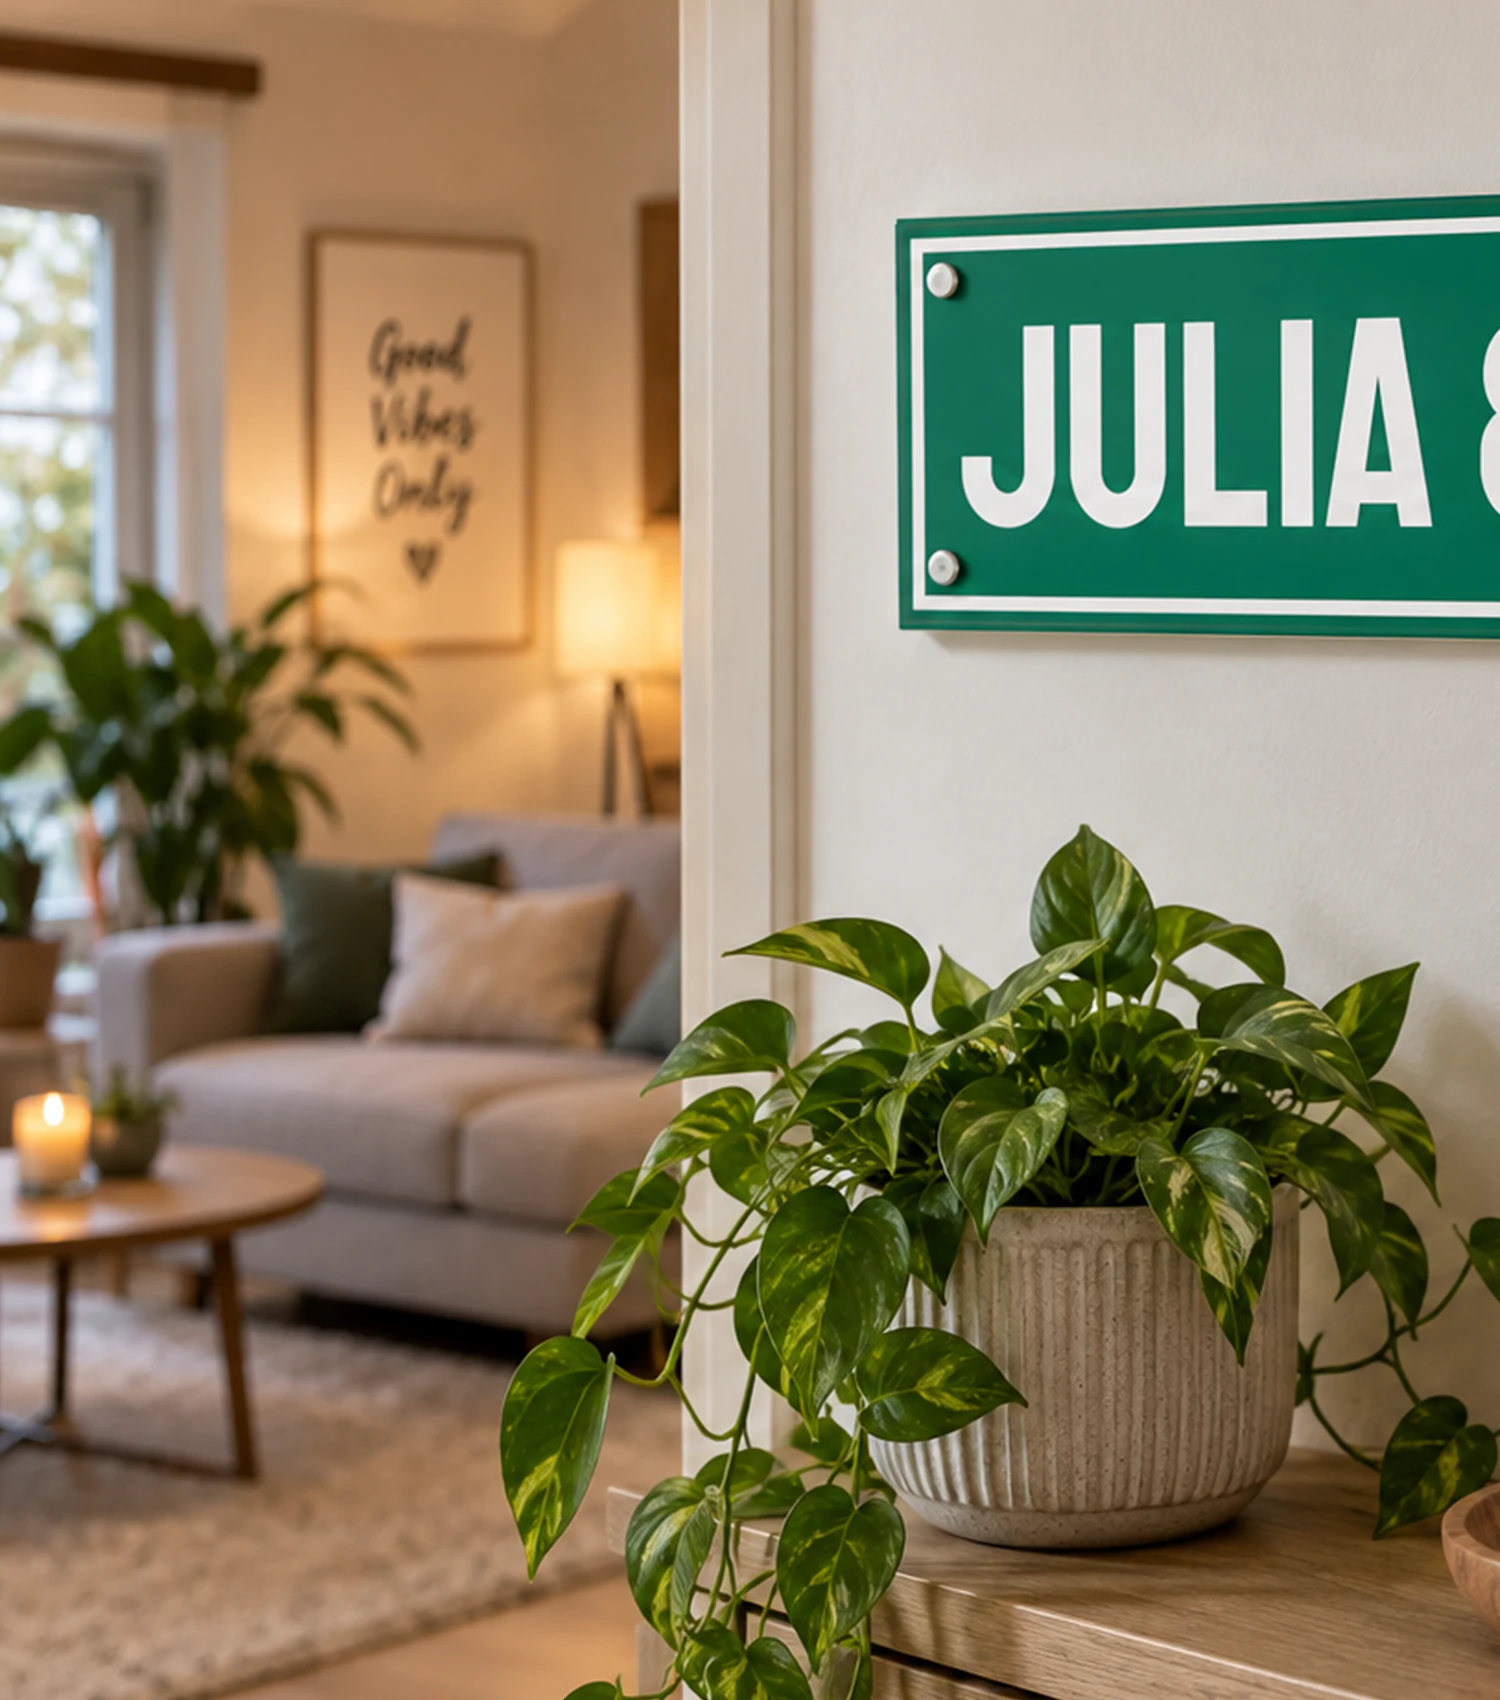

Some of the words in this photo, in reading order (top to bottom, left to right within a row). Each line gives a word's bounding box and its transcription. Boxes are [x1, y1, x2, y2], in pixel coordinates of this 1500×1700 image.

[369, 313, 472, 388] Good
[369, 385, 476, 452] Vibes
[961, 317, 1433, 529] JULIA
[372, 455, 473, 535] Only
